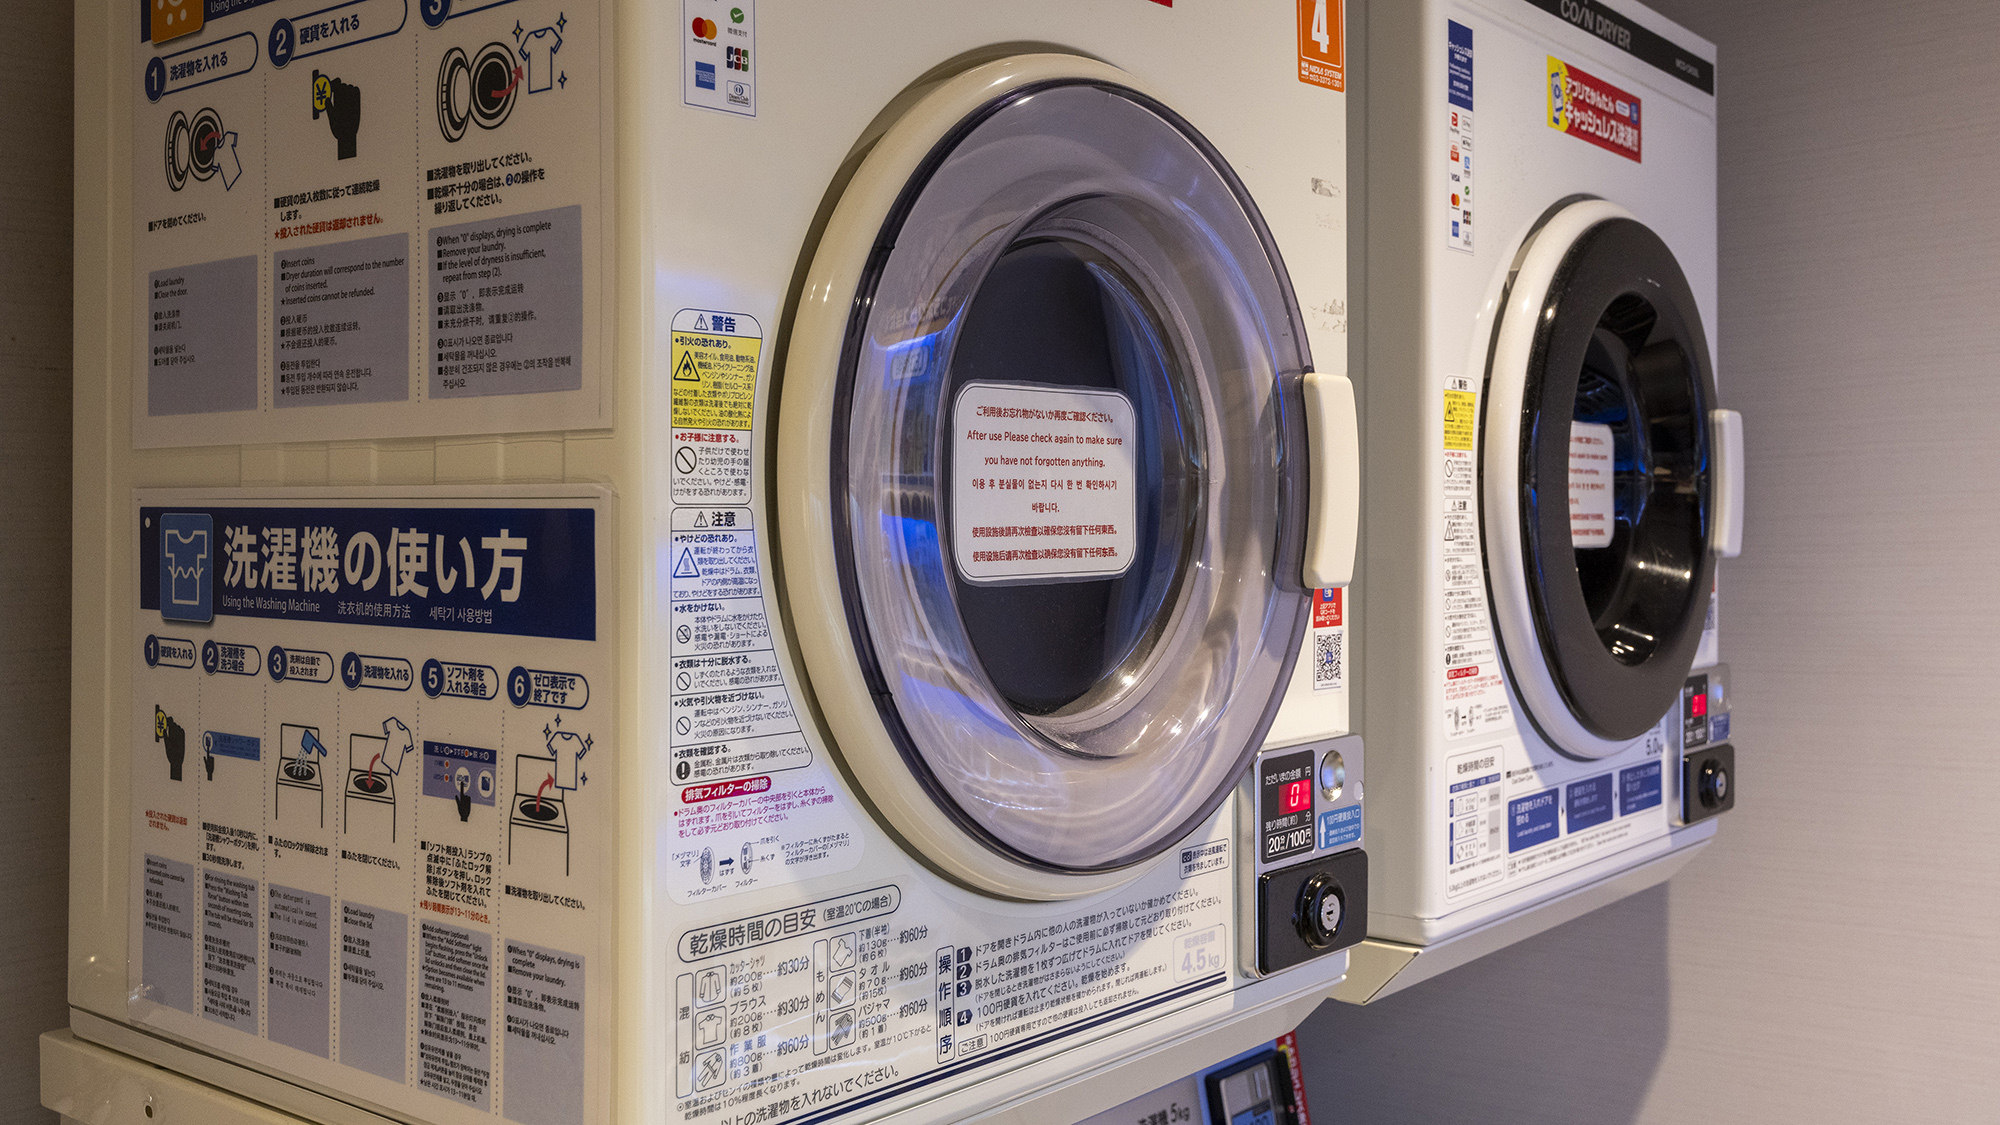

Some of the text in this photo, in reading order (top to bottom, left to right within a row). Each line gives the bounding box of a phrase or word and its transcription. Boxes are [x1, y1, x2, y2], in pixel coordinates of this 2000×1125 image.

[210, 0, 230, 13] Using
[299, 14, 360, 44] 硬貨を入れる
[1311, 0, 1329, 53] 4
[1595, 9, 1632, 50] DRYER
[275, 28, 287, 56] 2
[170, 52, 228, 80] 洗濯物を入れる
[152, 67, 158, 90] 1
[434, 152, 532, 179] 洗濯物を取り出してください。
[434, 195, 502, 215] 繰り返してください。
[443, 221, 552, 245] When "0" displays, drying is complete
[443, 241, 506, 258] Remove your laundry.
[286, 271, 300, 281] Dryer
[301, 268, 322, 278] duration
[324, 266, 333, 276] will
[334, 262, 364, 274] correspond
[372, 260, 381, 269] the
[382, 257, 404, 268] number
[287, 257, 314, 268] Insert coins
[285, 280, 328, 293] of coins inserted.
[286, 286, 375, 305] Inserted coins cannot be refunded.
[712, 315, 736, 333] 警告
[680, 335, 731, 349] 引火の恐れあり。
[976, 405, 1113, 423] ご利用後お忘れ物がないか再度ご確認ください。
[680, 432, 739, 444] お子様に注意する。
[967, 430, 1123, 446] After use Please check again to make sure
[985, 455, 1105, 468] you have not forgotten anything.
[699, 467, 749, 477] くところで使わな
[972, 479, 1117, 491] 이용 후 분실물이 없는지 다시 한 번 확인하시기
[1032, 502, 1060, 513] 바랍니다.
[711, 512, 736, 527] 注意
[680, 533, 737, 544] やけどの恐れあり。
[222, 525, 528, 602] 洗濯機の使い方
[222, 595, 320, 614] Using the Washing Machine
[337, 600, 410, 619] 洗衣机的使用方法
[679, 603, 725, 614] 水をかけない。
[429, 607, 492, 625] 세탁기 사용방법
[148, 643, 154, 659] 1
[207, 647, 214, 666] 2
[273, 653, 281, 673] 3
[347, 660, 357, 680] 4
[679, 655, 751, 670] 衣類は十分に脱水する。
[364, 665, 409, 681] 洗濯物を入れる
[428, 667, 438, 689] 5
[447, 667, 484, 682] ソフト剤を
[533, 674, 575, 690] ゼロ表示で
[447, 680, 487, 696] 入れる場合
[515, 675, 525, 697] 6
[533, 689, 567, 704] 終了です
[679, 691, 765, 708] 火気や引火物を近づけない。
[679, 744, 731, 759] 衣類を確認する。
[685, 777, 769, 802] 排気フィルターの掃除
[1290, 783, 1300, 807] 0
[687, 885, 727, 898] フィルターカバー
[690, 909, 816, 957] 乾燥時間の目安
[900, 925, 928, 945] 約60分
[729, 955, 766, 974] カッターシャツ
[777, 956, 809, 977] 約30分
[900, 962, 928, 981] 約60分
[777, 995, 809, 1016] 約30分
[938, 953, 953, 1056] 操作順序
[777, 1035, 809, 1056] 約60分
[961, 1036, 985, 1053] ご注意
